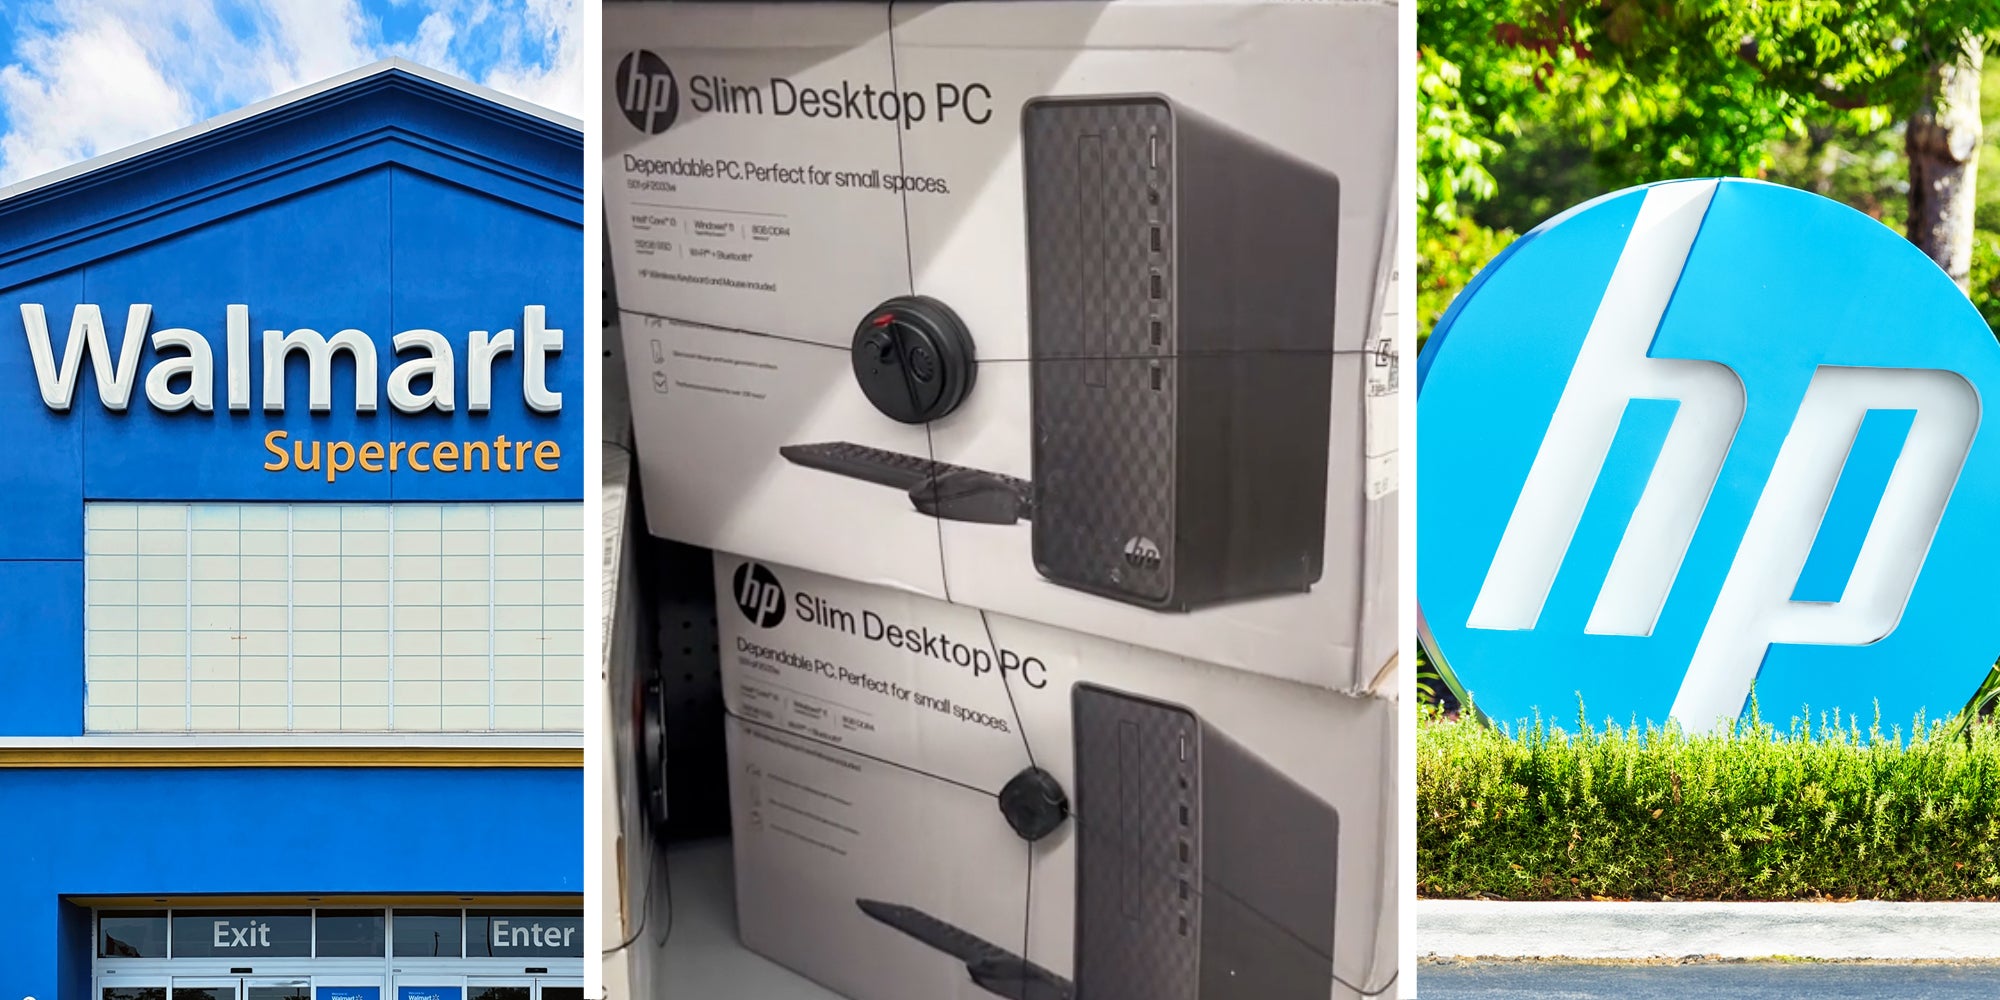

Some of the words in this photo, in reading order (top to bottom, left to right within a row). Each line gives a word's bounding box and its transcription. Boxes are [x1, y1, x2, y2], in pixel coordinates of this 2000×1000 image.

[625, 49, 671, 135] hp
[689, 75, 763, 115] Slim
[770, 78, 926, 130] Desktop
[936, 82, 993, 125] PC
[624, 153, 715, 179] Dependable
[716, 159, 744, 181] PC.
[745, 161, 805, 185] Perfect
[808, 164, 832, 187] for
[835, 168, 881, 189] small
[883, 172, 950, 195] spaces.
[20, 304, 564, 414] Walmart
[264, 430, 561, 482] Supercentre
[1465, 178, 1983, 740] hp
[740, 562, 781, 628] hp
[795, 592, 856, 635] Slim
[863, 610, 992, 678] Desktop
[1000, 649, 1048, 689] PC
[736, 636, 814, 674] Dependable
[814, 657, 837, 680] PC.
[838, 665, 889, 697] Perfect
[890, 683, 911, 703] for
[913, 690, 951, 714] small
[952, 702, 1011, 734] spaces.
[213, 920, 271, 948] Exit
[493, 920, 576, 948] Enter
